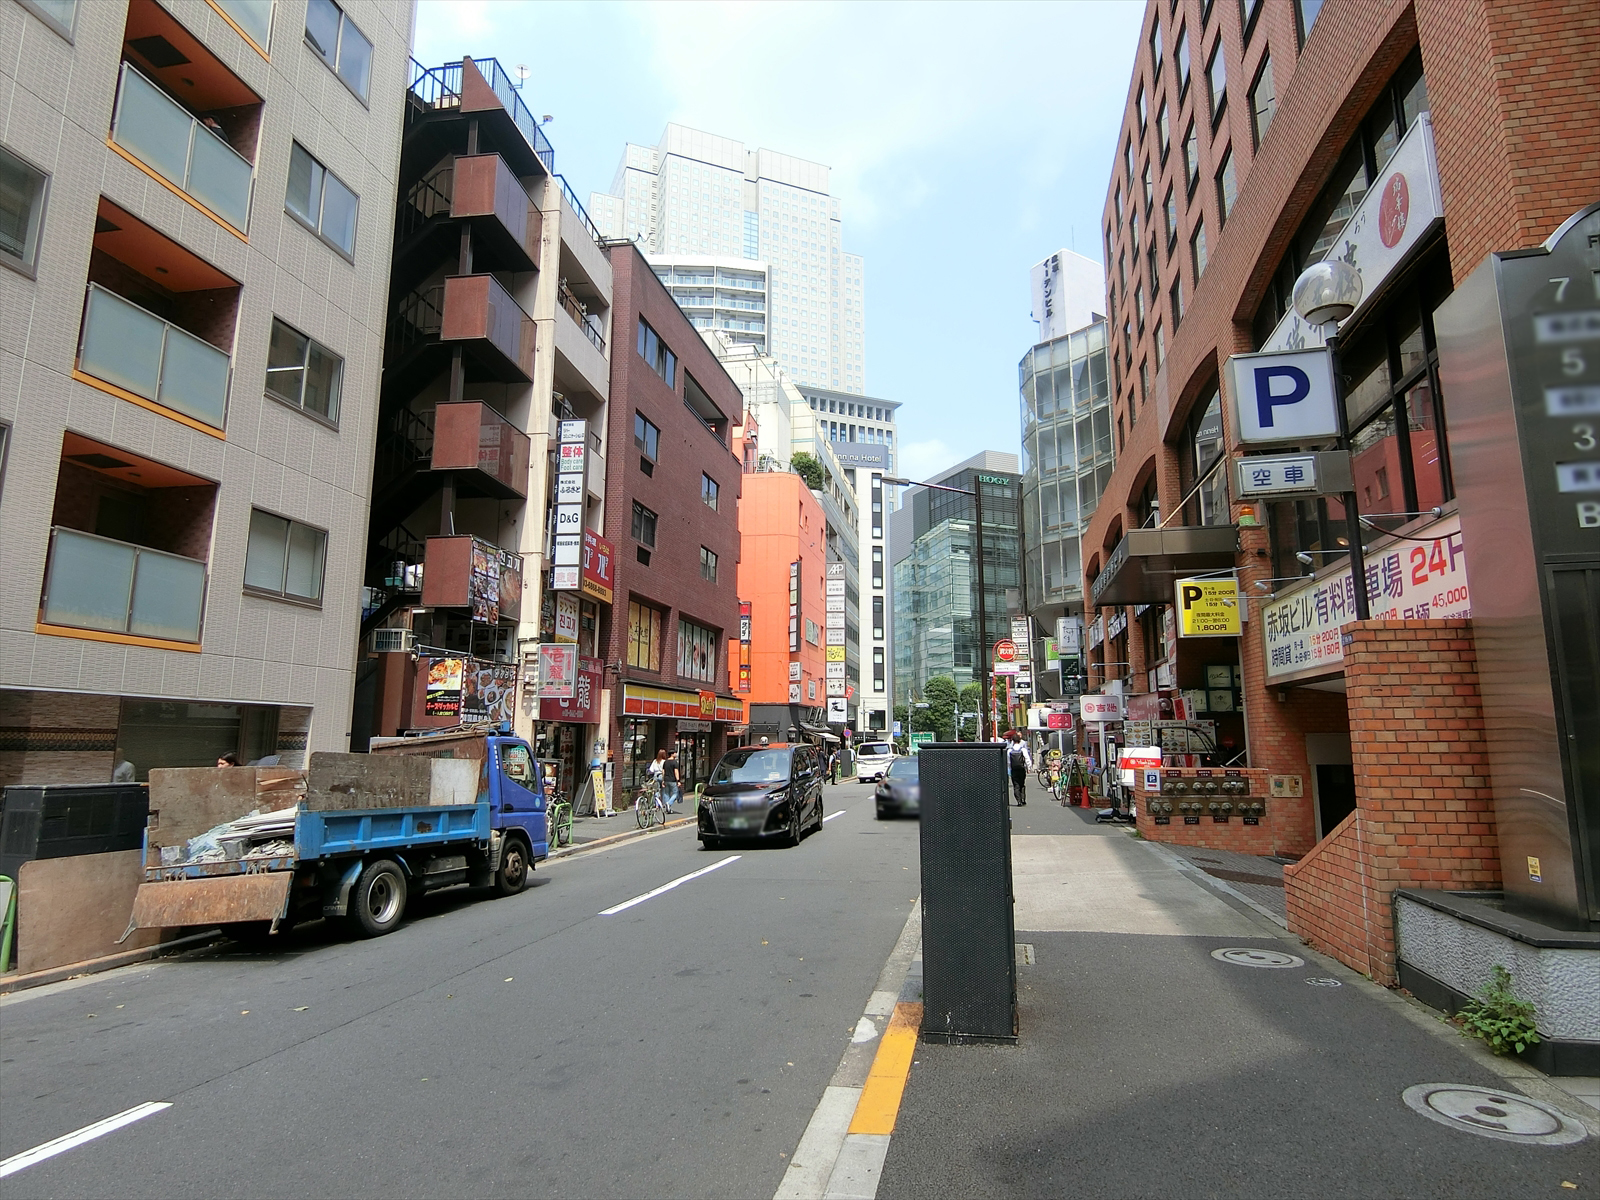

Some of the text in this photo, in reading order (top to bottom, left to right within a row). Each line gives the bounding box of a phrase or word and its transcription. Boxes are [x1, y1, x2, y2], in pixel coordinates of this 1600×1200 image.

[1549, 277, 1570, 301] 7
[1562, 349, 1585, 375] 5
[1253, 365, 1311, 428] P
[1573, 424, 1597, 450] 3
[562, 446, 583, 458] 整体
[861, 454, 882, 463] Hotel
[1252, 465, 1305, 486] 空車
[560, 513, 579, 523] D&G
[1183, 586, 1203, 610] P
[1431, 585, 1468, 608] 45,000
[1196, 623, 1227, 631] 1,800円
[1271, 643, 1292, 667] 時間貸
[1321, 627, 1339, 643] 200円
[1323, 641, 1340, 655] 150円
